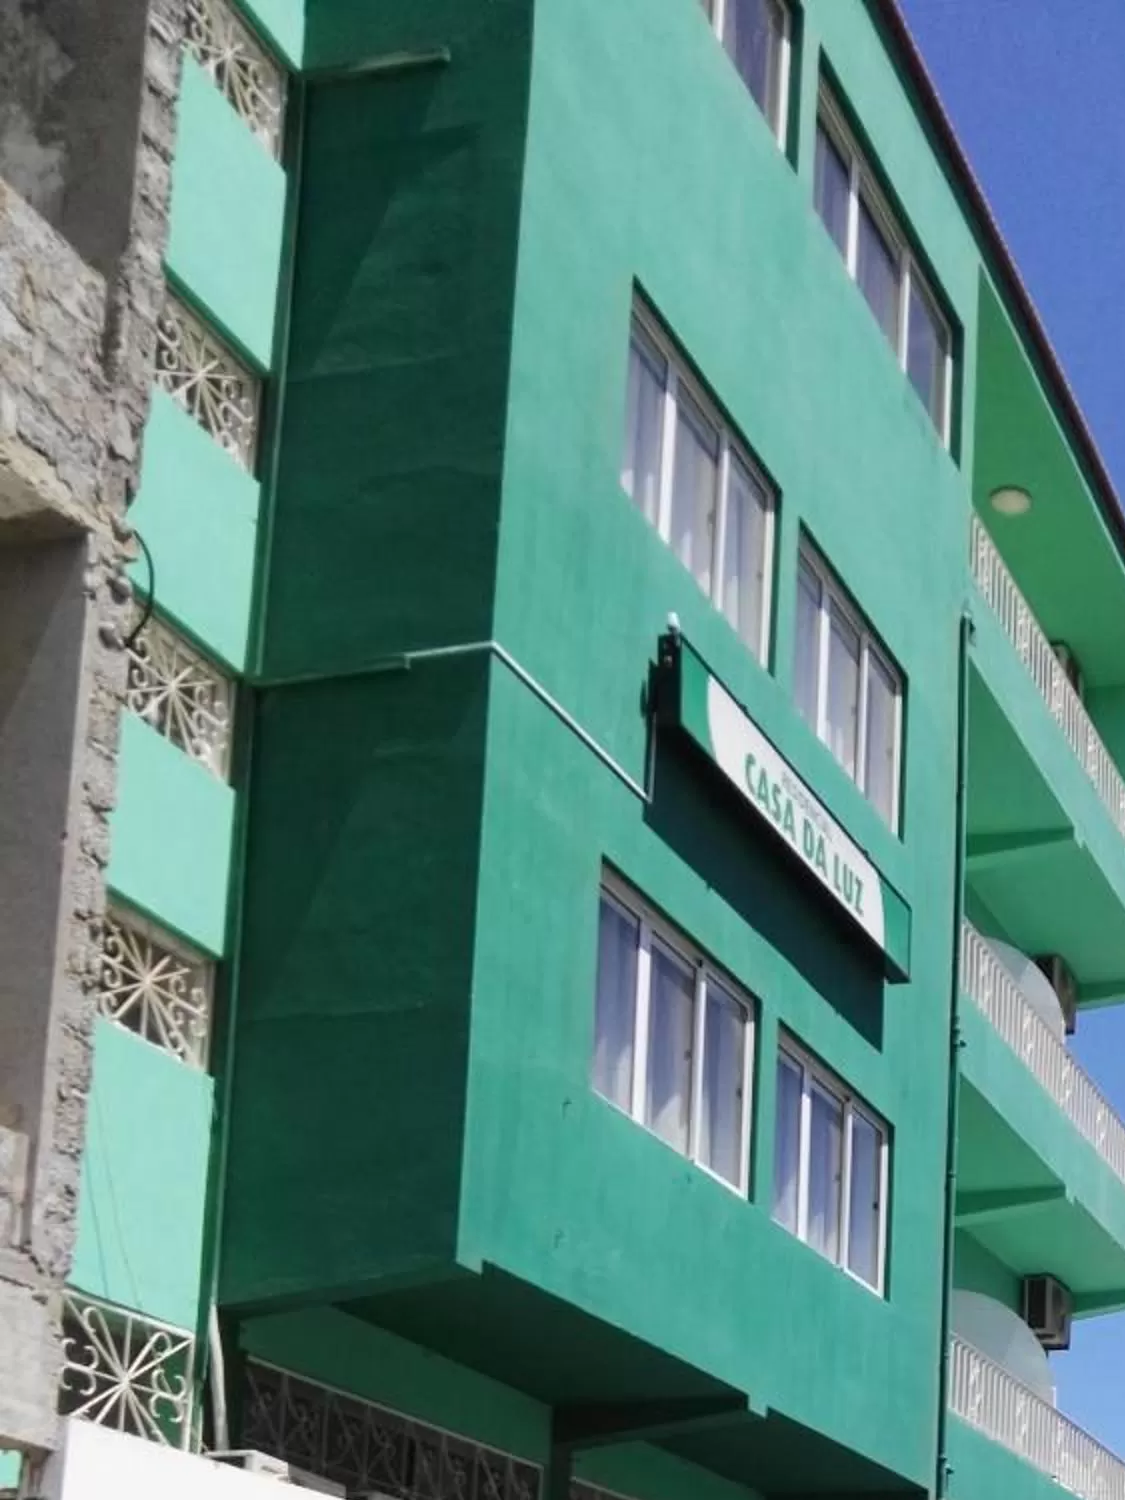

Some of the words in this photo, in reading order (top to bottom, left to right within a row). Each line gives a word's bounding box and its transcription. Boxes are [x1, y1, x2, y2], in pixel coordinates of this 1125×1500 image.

[744, 753, 797, 844] CASA
[803, 817, 828, 878] DA
[833, 853, 865, 918] LUZ
